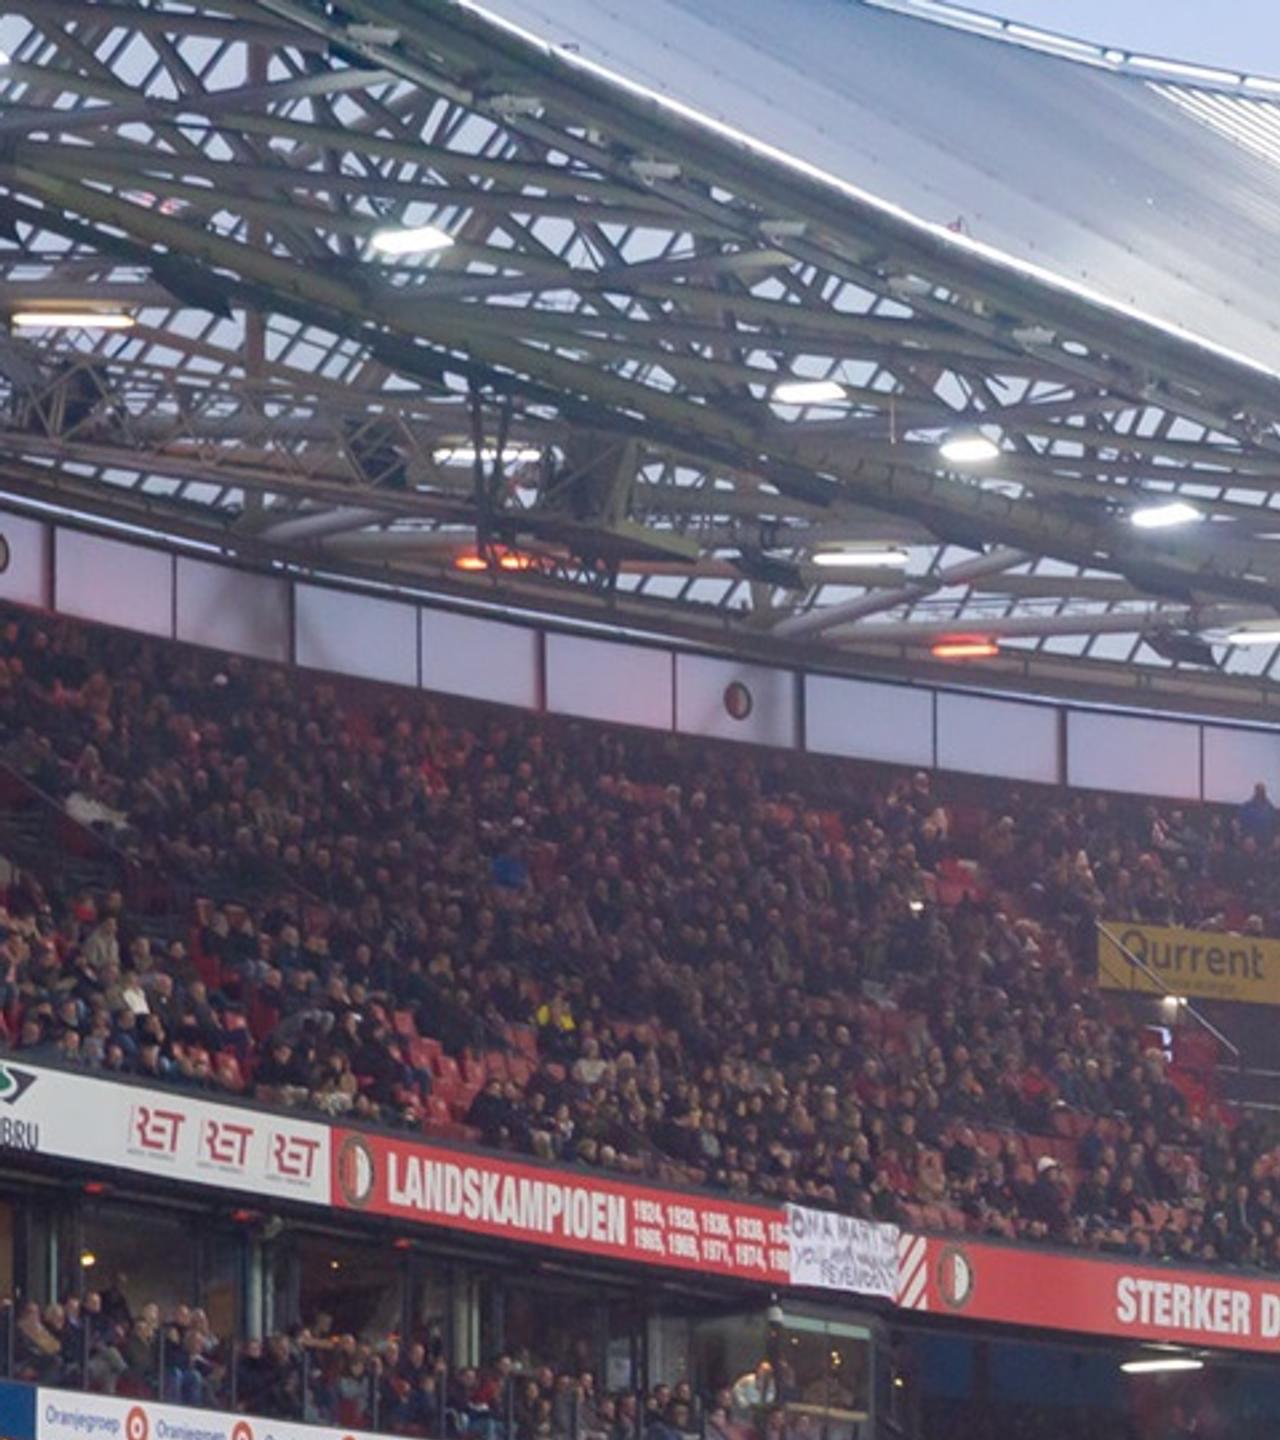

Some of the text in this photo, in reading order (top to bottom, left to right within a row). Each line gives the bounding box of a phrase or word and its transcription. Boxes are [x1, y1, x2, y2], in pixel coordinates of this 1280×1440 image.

[1120, 929, 1265, 979] Qurrent
[387, 1151, 627, 1247] LANDSKAMPIOEN
[1116, 1276, 1251, 1337] STERKER
[45, 1405, 121, 1435] Oranjegroep
